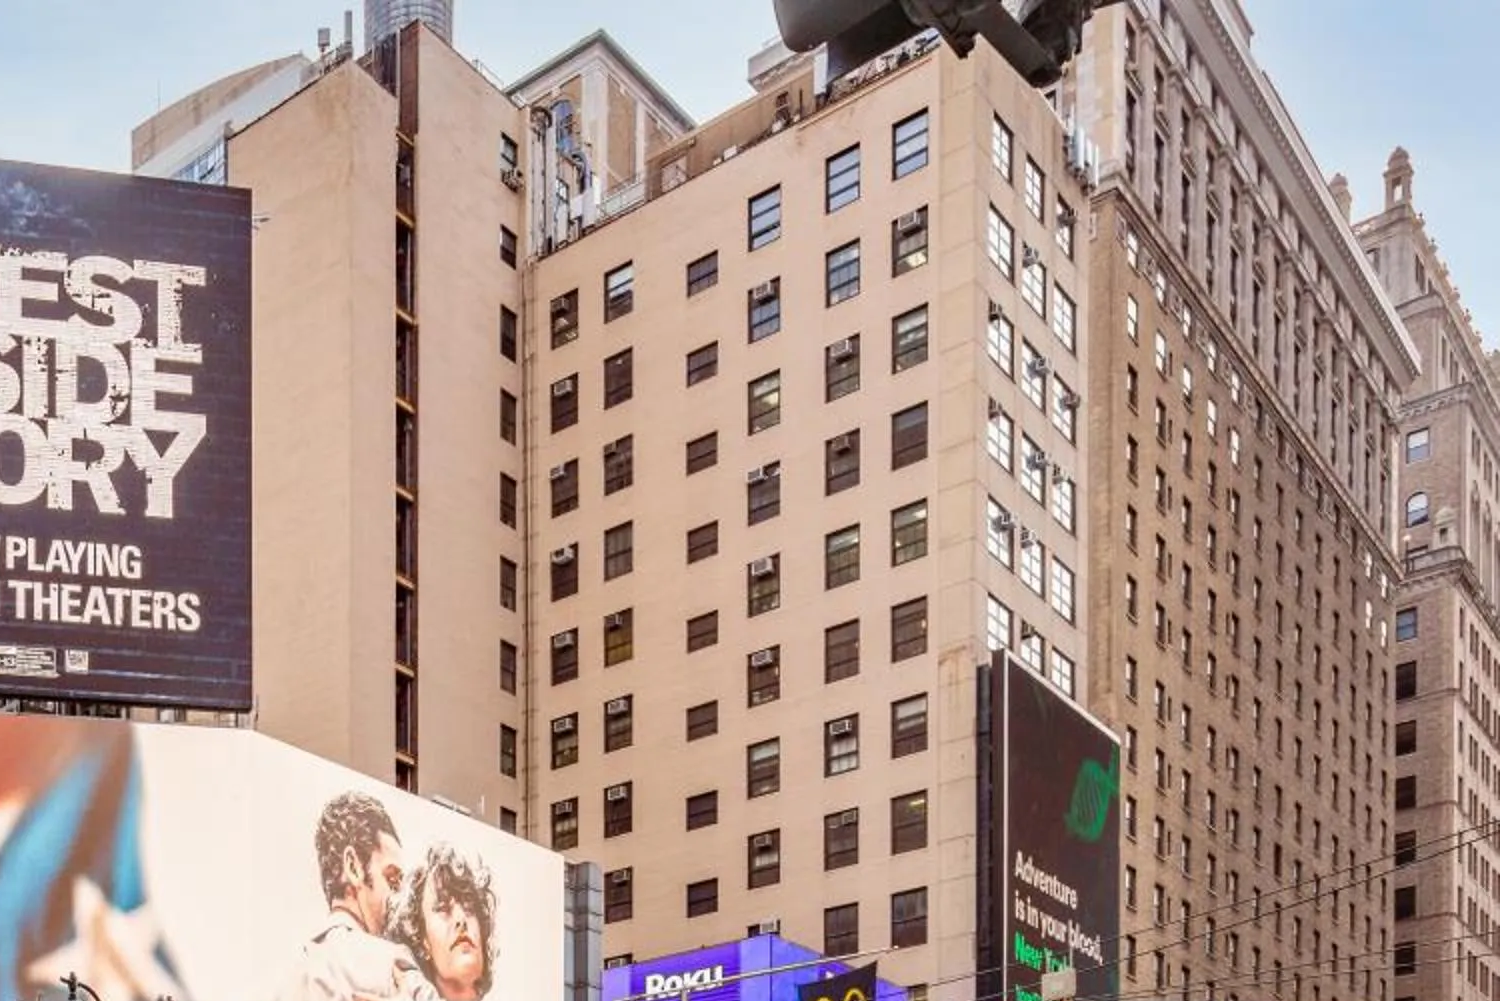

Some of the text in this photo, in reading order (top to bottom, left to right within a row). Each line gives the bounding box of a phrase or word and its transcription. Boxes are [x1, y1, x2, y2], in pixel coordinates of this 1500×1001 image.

[5, 536, 142, 580] PLAYING
[7, 579, 201, 632] THEATERS
[1014, 850, 1078, 910] Adventure
[1014, 890, 1105, 967] is in your blood,
[1014, 930, 1043, 971] New
